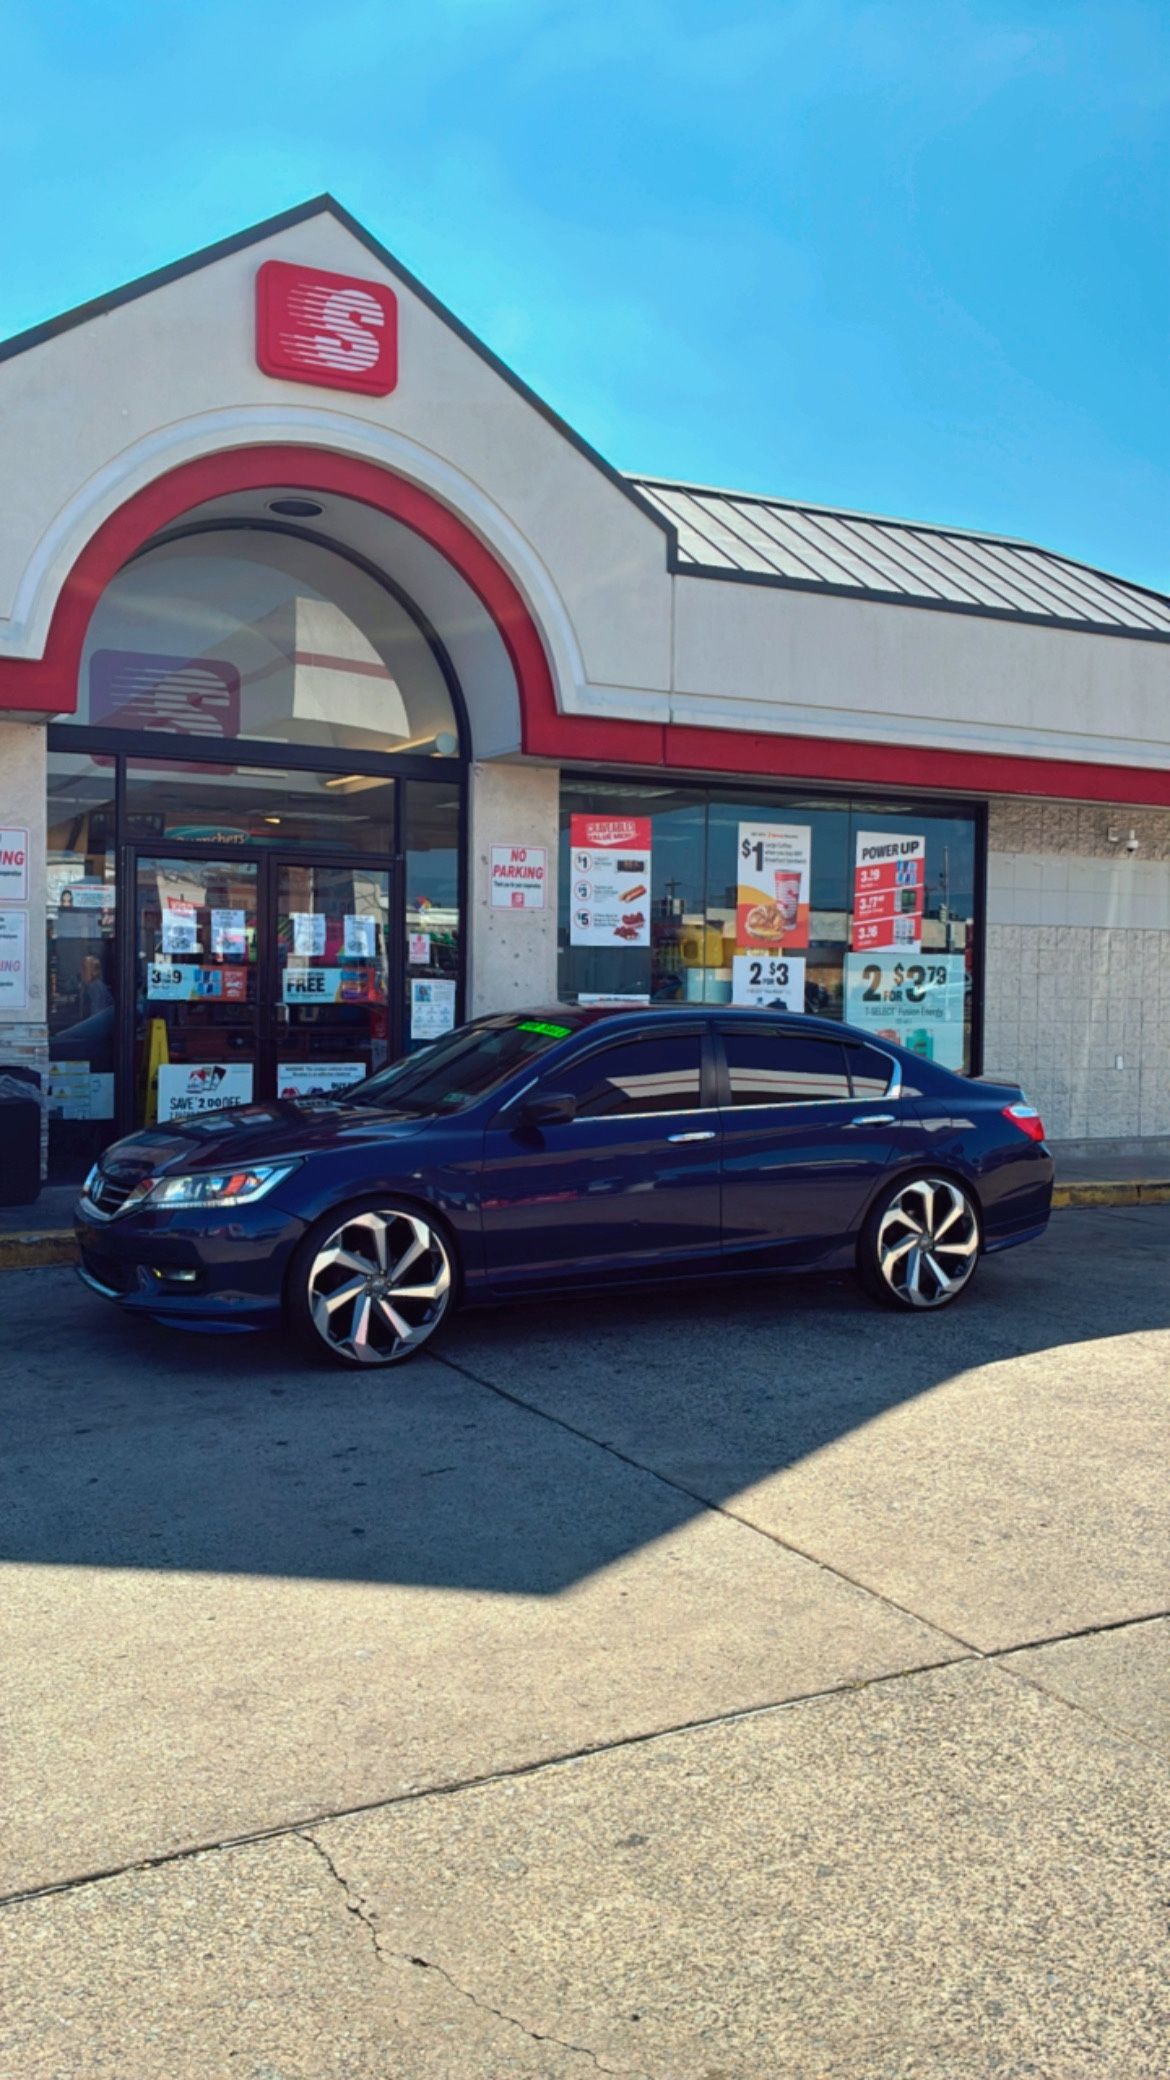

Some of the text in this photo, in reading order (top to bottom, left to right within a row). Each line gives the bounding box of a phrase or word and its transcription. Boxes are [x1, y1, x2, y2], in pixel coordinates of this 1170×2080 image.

[286, 284, 385, 373] S
[511, 847, 527, 863] NO
[741, 838, 763, 872] $1
[862, 840, 920, 861] POWER UP
[493, 864, 544, 880] PARKING
[749, 962, 762, 986] 2
[862, 964, 882, 1002] 2
[883, 990, 903, 1002] FOR
[286, 978, 326, 993] FREE
[170, 1096, 193, 1110] SAVE
